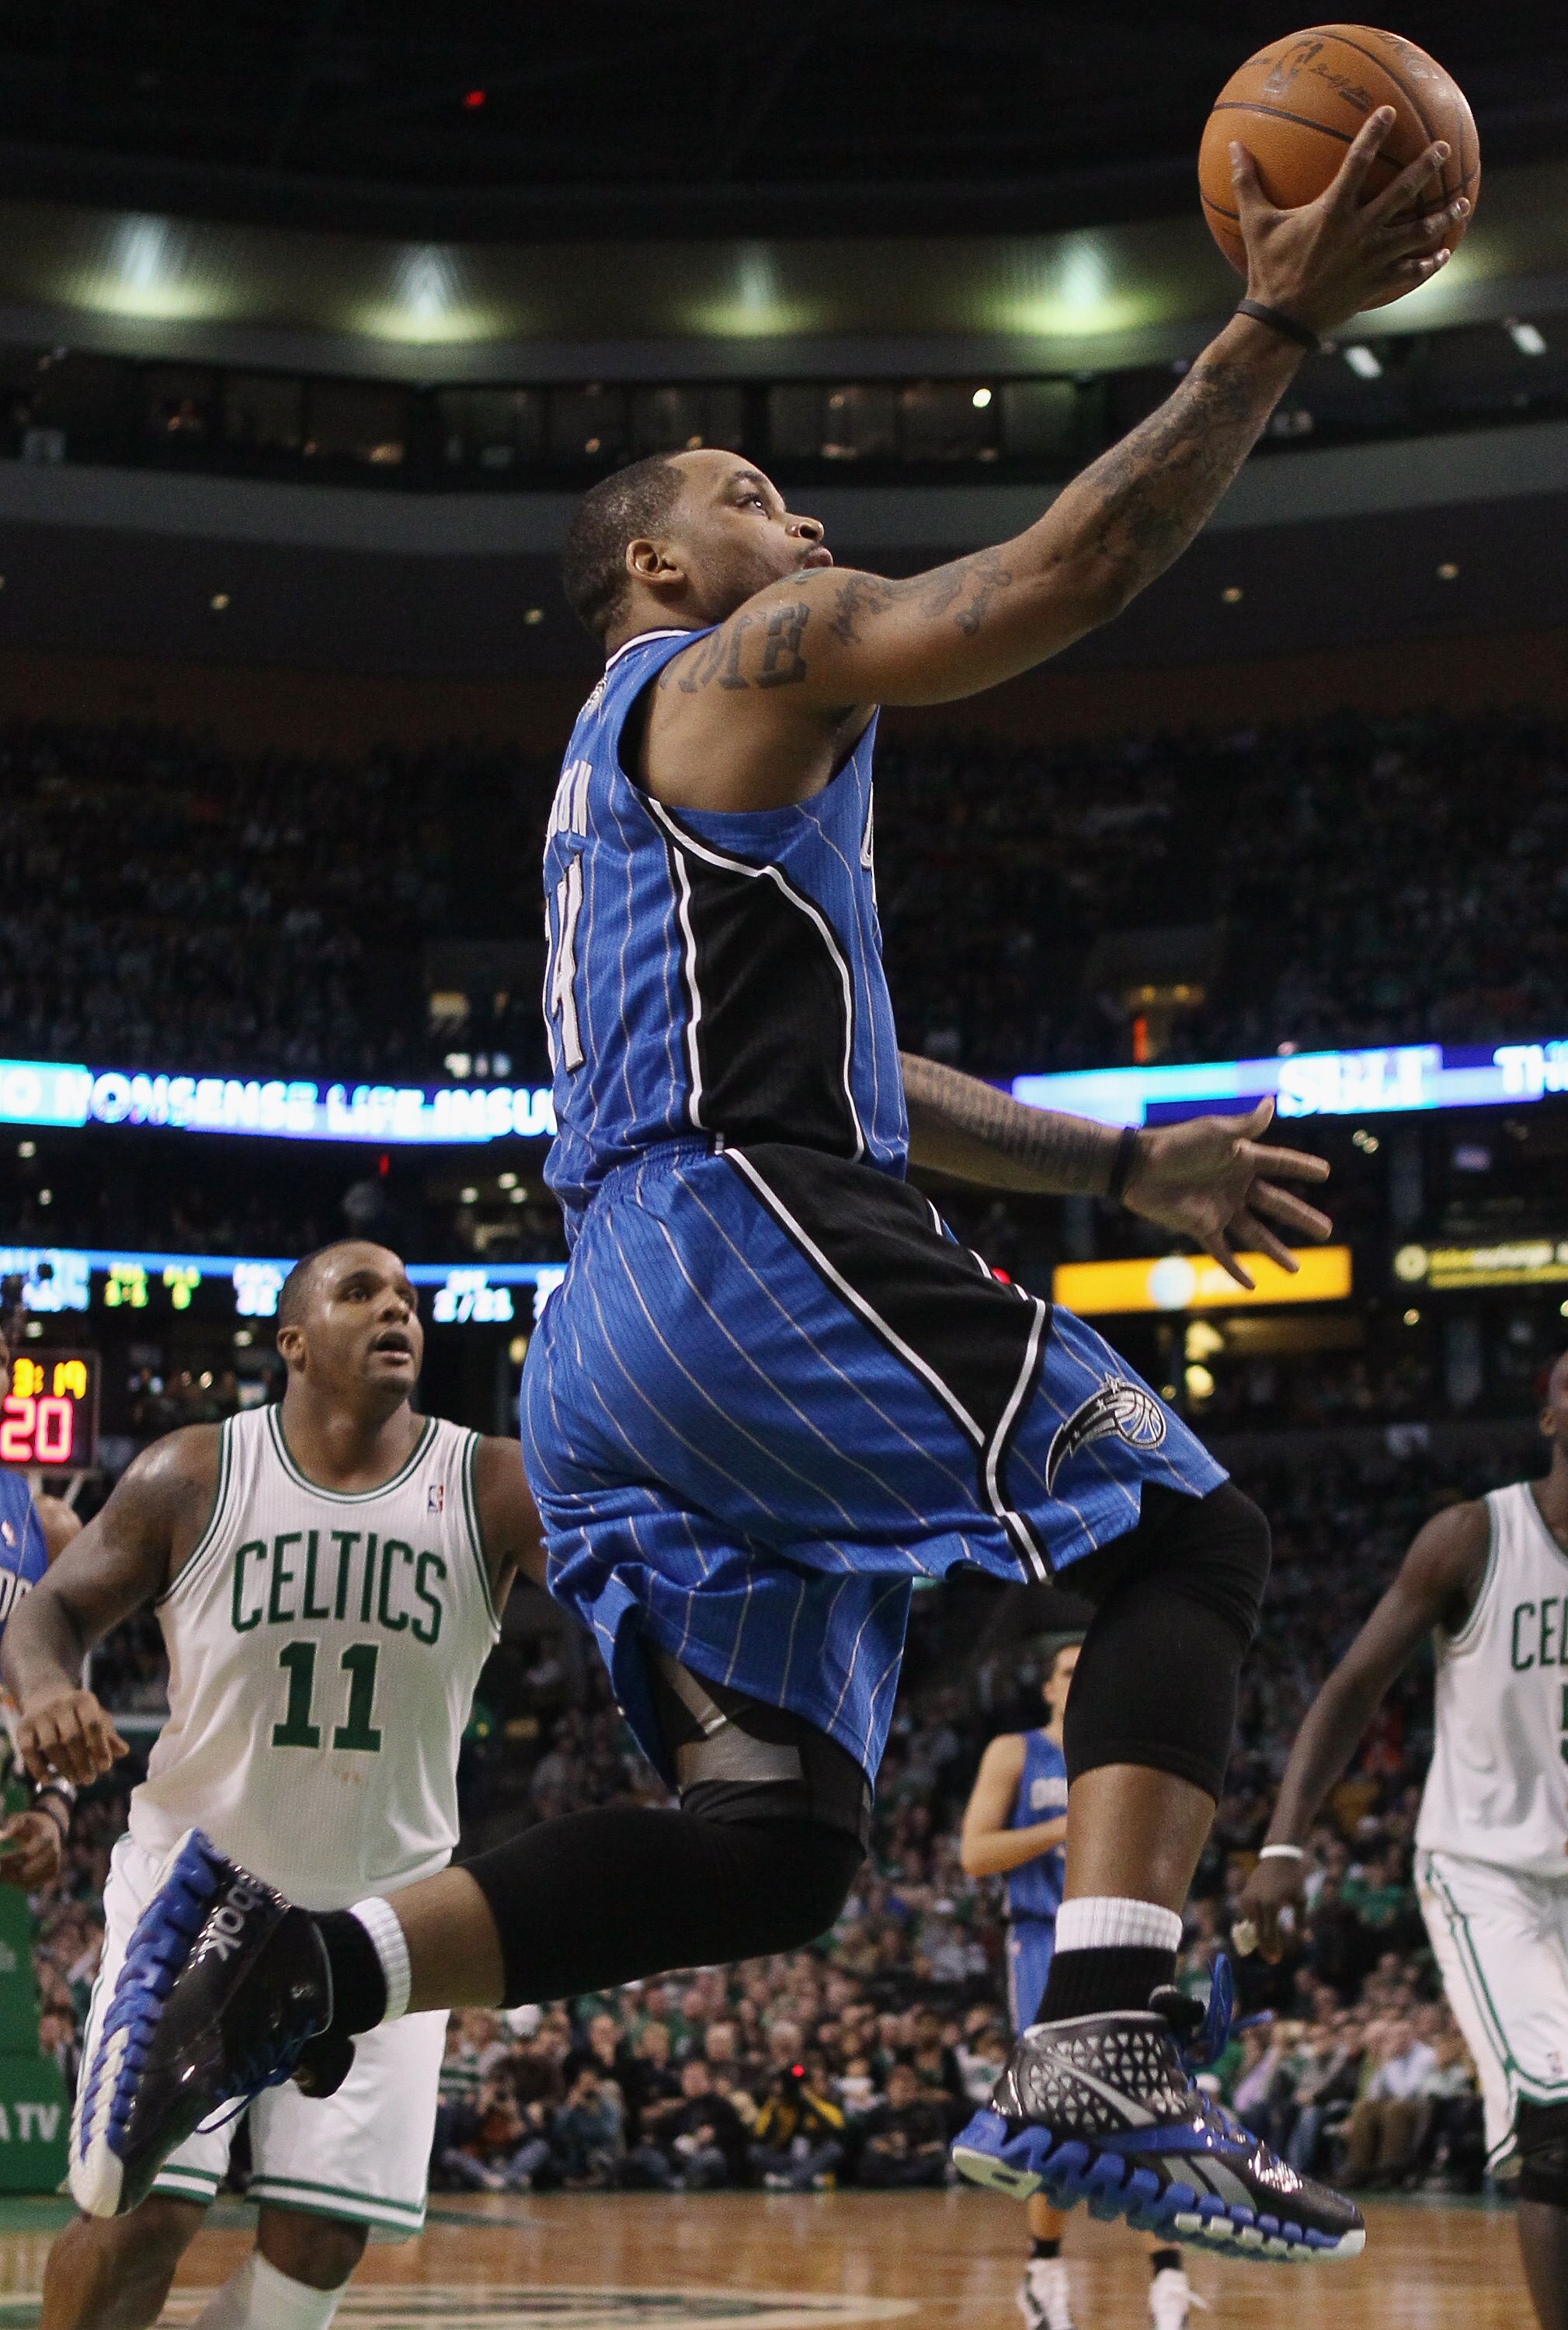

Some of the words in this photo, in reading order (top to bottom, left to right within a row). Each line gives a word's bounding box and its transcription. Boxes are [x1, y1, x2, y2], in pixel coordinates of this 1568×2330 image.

[53, 1069, 318, 1131] NONSENSE
[326, 1083, 426, 1135] LIFE
[1, 1394, 73, 1463] 20
[232, 1530, 447, 1646] CELTICS
[1511, 1594, 1568, 1671] CEL
[272, 1640, 381, 1752] 11
